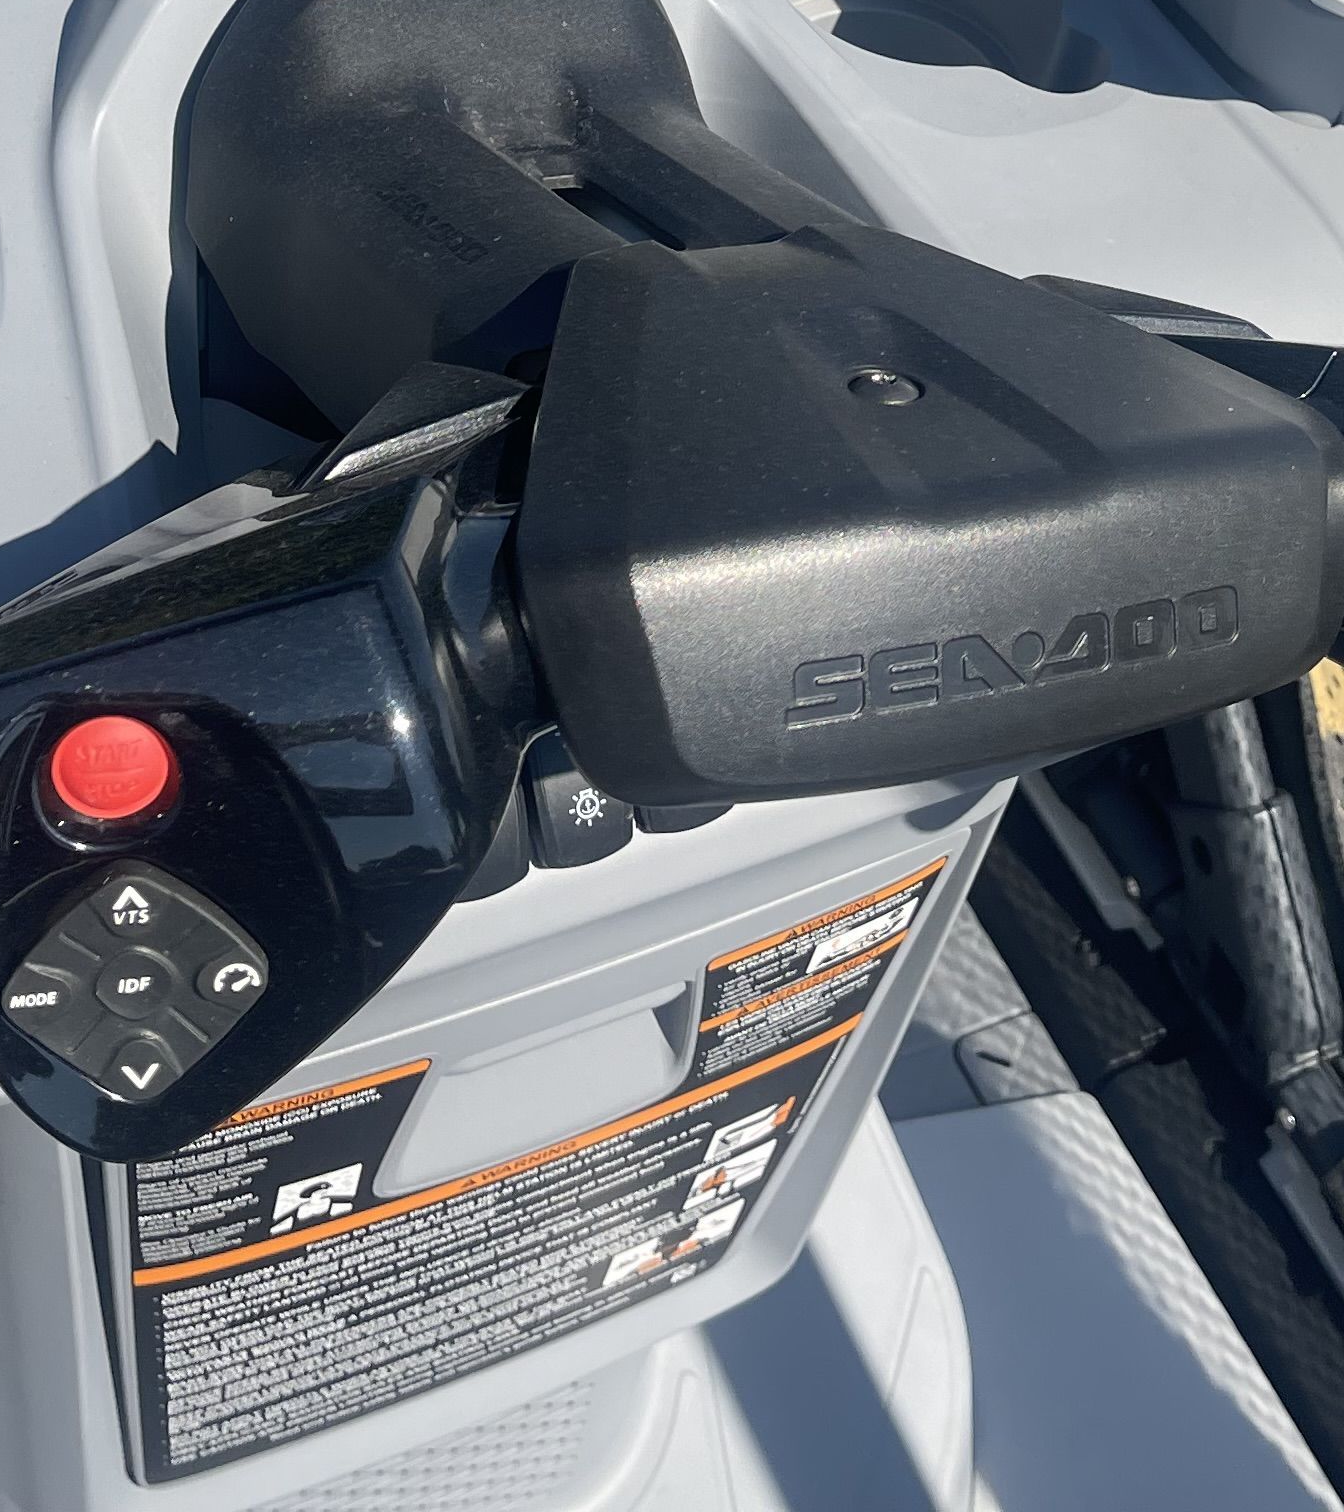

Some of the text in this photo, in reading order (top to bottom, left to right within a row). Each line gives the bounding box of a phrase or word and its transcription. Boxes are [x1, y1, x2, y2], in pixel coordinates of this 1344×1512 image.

[112, 908, 150, 925] VTS
[801, 894, 877, 937] WARNING
[9, 975, 151, 1009] MODE IDF
[239, 1088, 335, 1122] WARNING
[480, 1140, 578, 1182] WARNING
